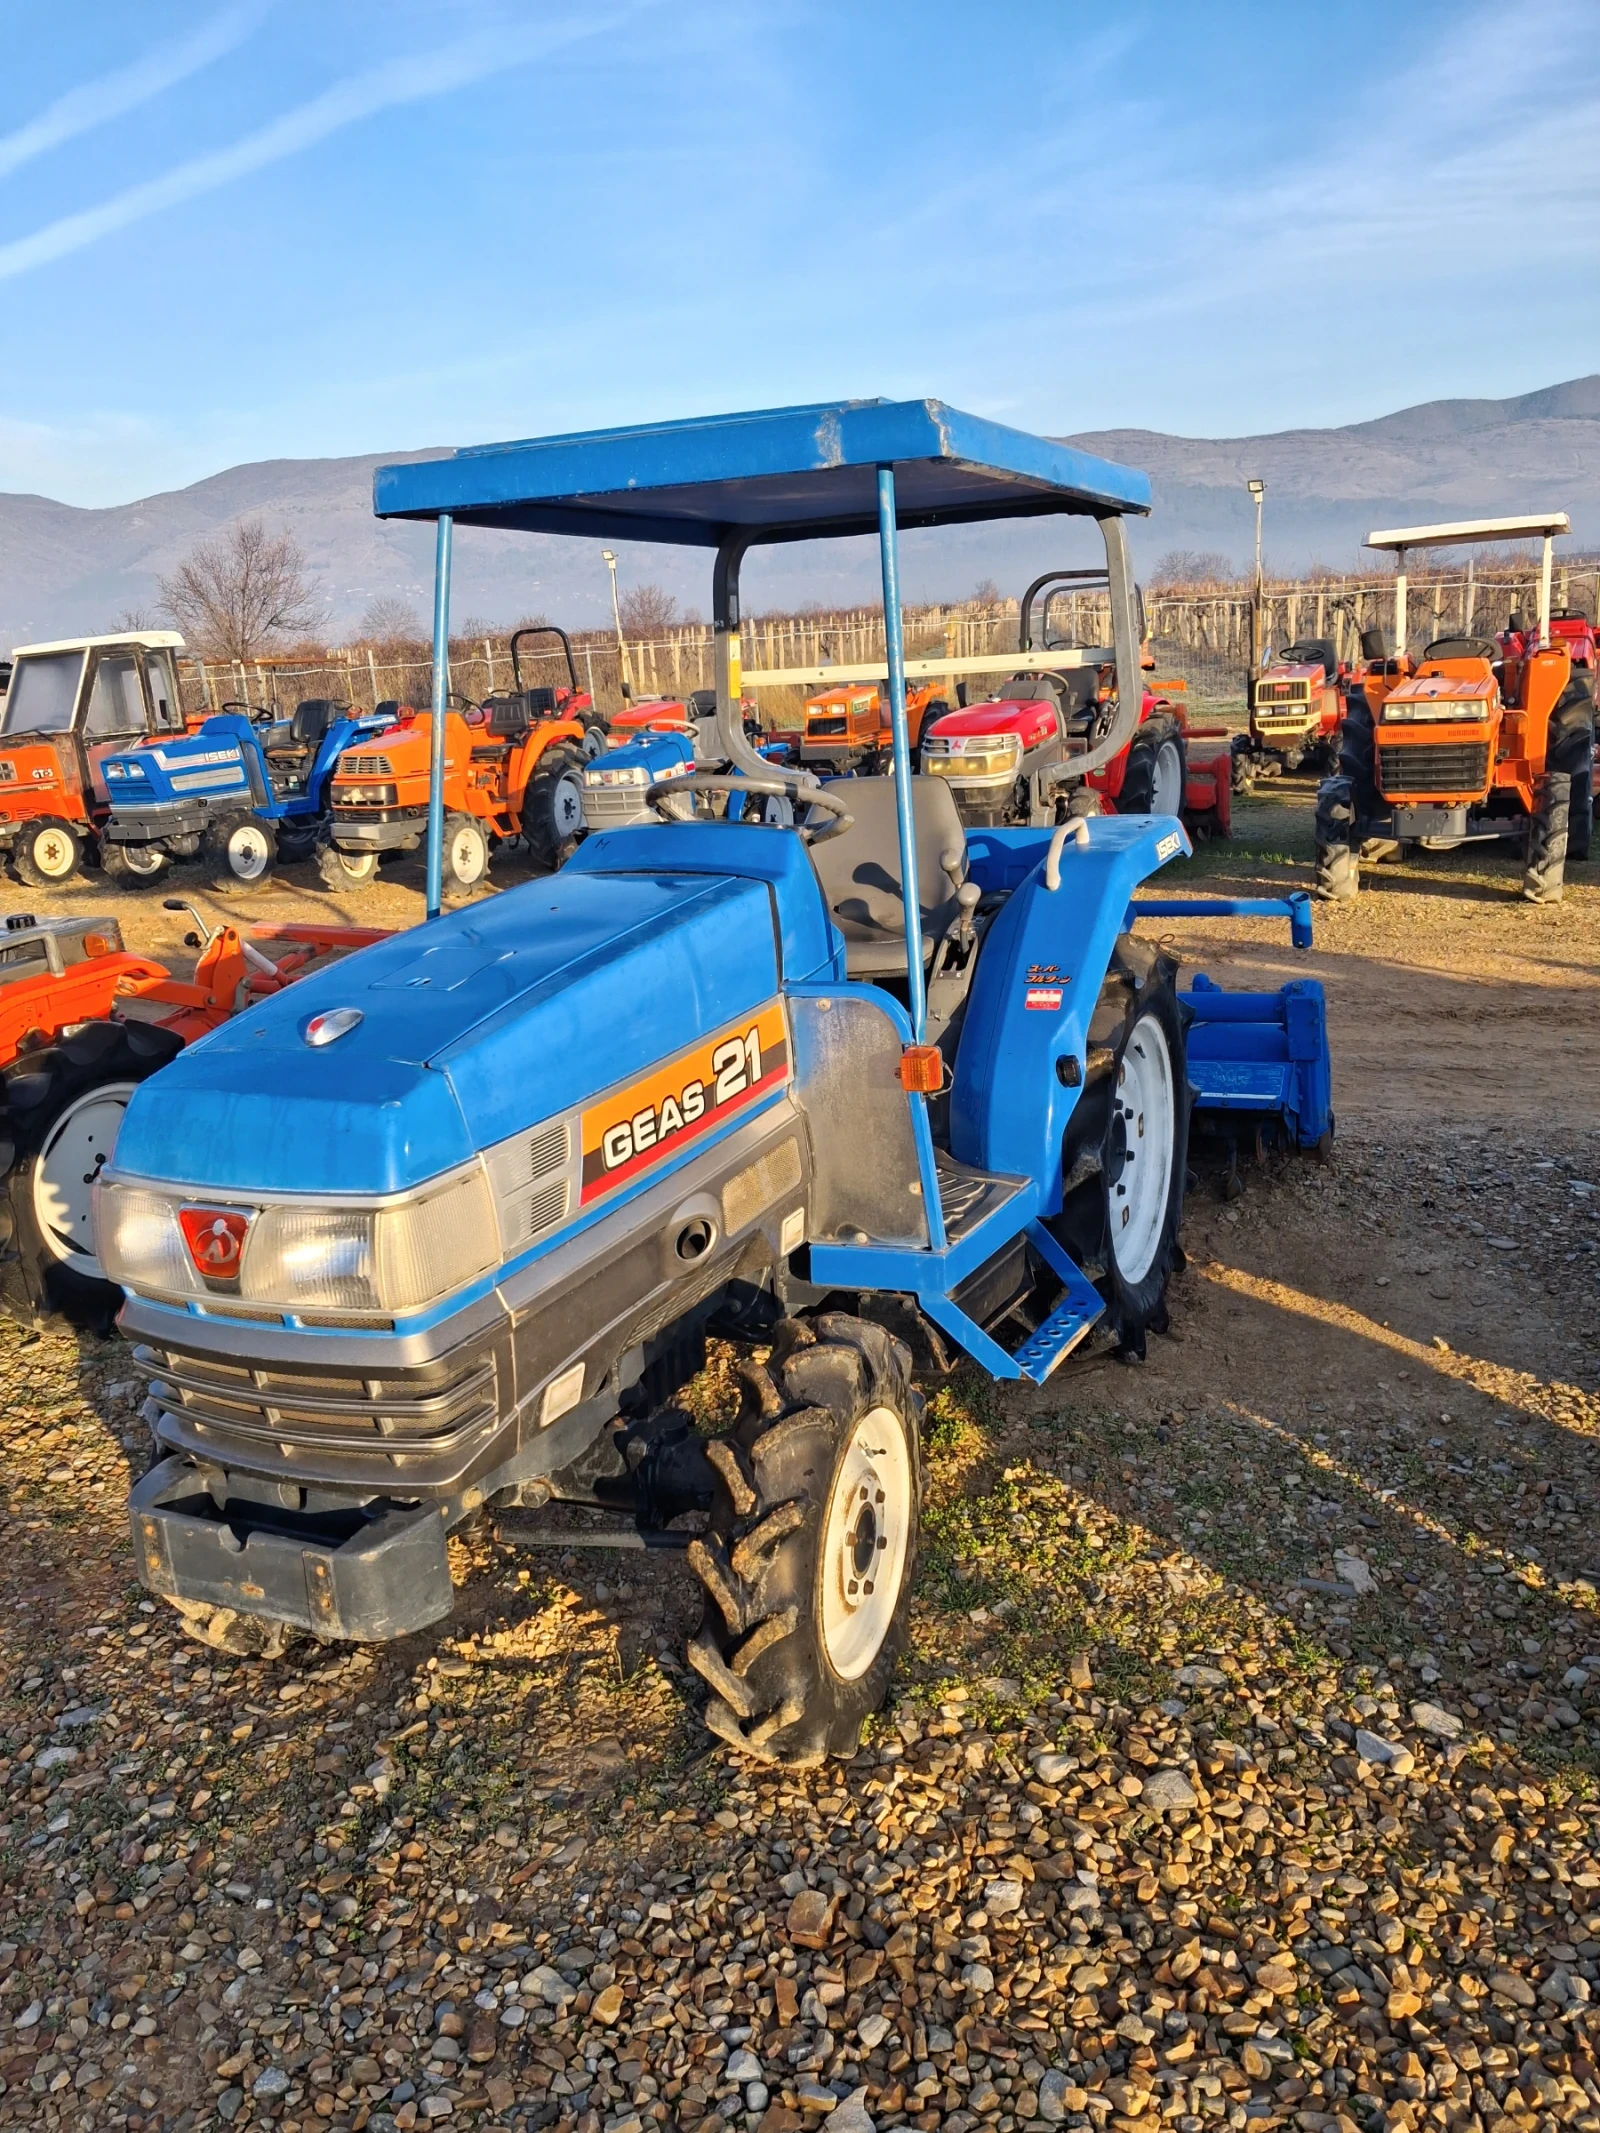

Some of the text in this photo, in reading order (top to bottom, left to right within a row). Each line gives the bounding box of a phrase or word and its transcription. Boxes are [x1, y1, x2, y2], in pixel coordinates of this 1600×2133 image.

[204, 748, 240, 762] ISEKI
[602, 1025, 763, 1171] GEAS 21
